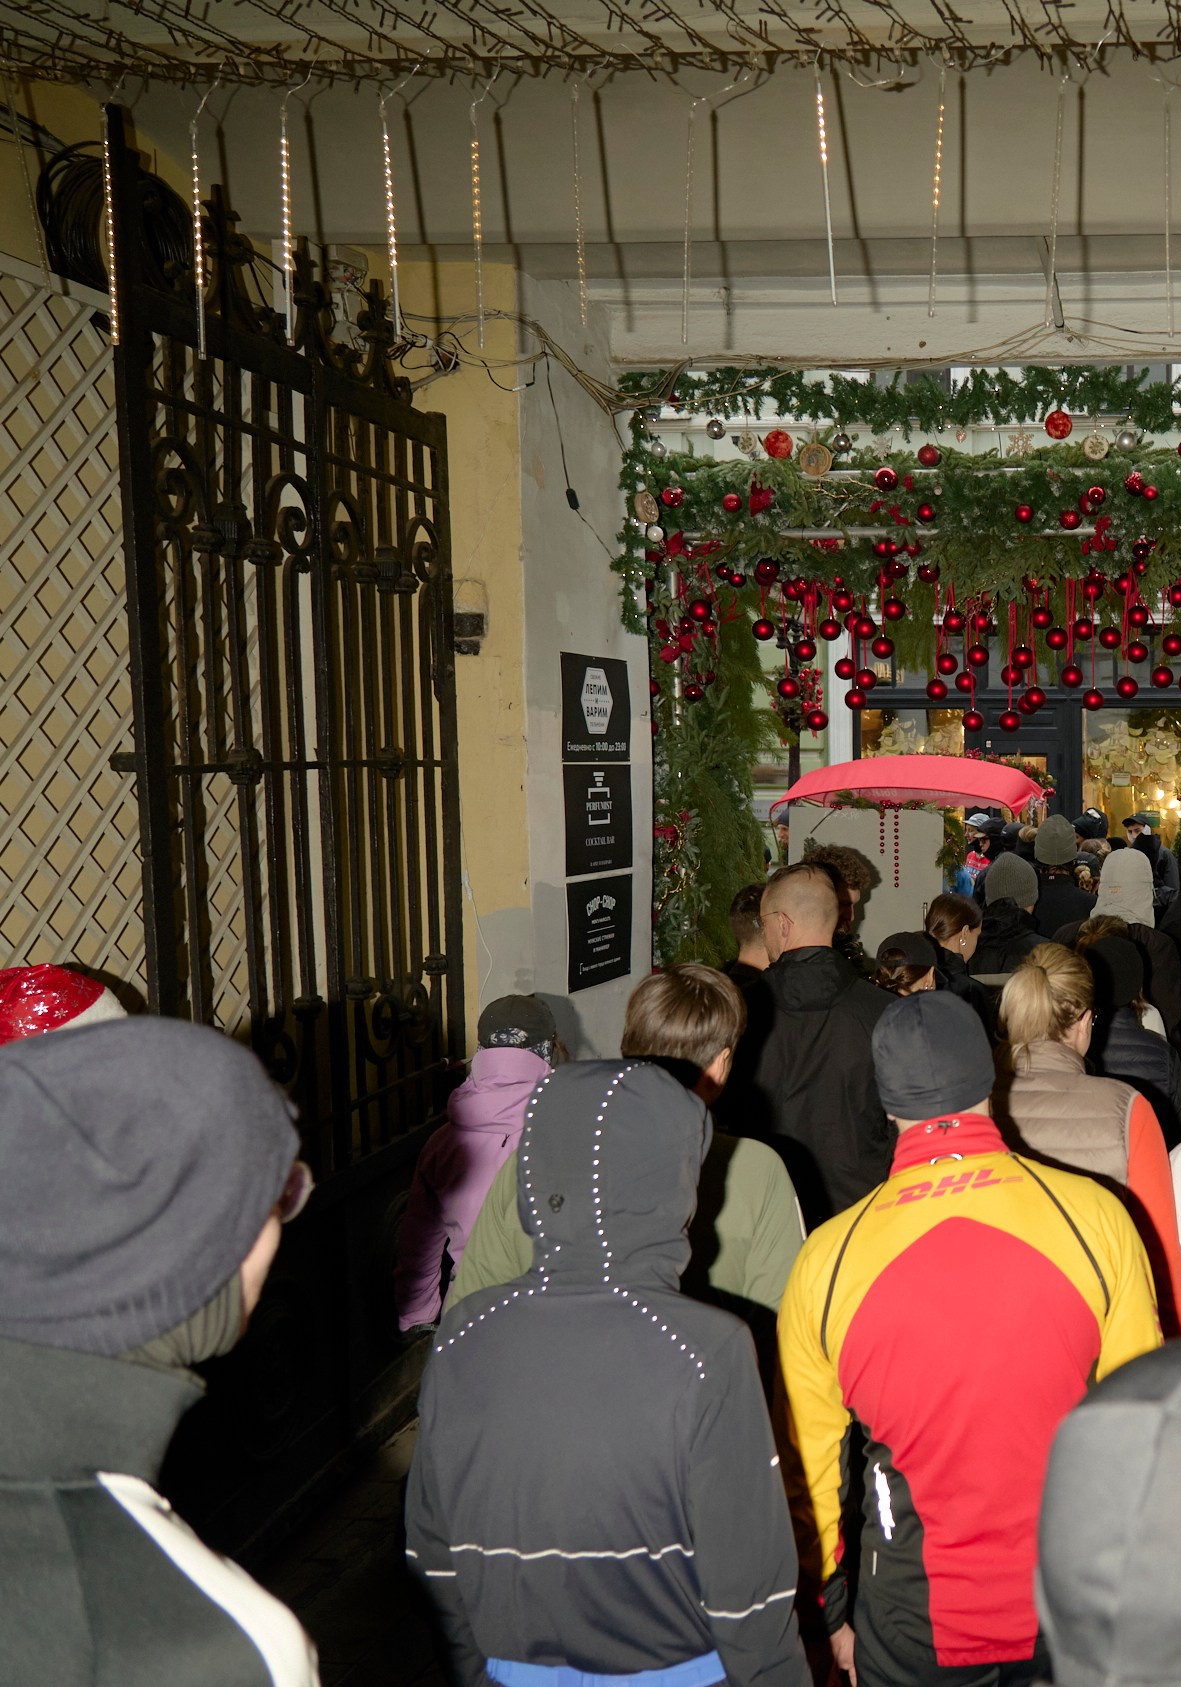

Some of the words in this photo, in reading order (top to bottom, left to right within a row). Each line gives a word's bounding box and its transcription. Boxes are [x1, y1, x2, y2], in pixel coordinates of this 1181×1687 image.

[586, 683, 608, 696] ЛЕПИМ
[586, 706, 608, 718] ВАРИМ
[586, 894, 616, 916] CHOP-CHOP
[895, 1168, 1002, 1206] DHL
